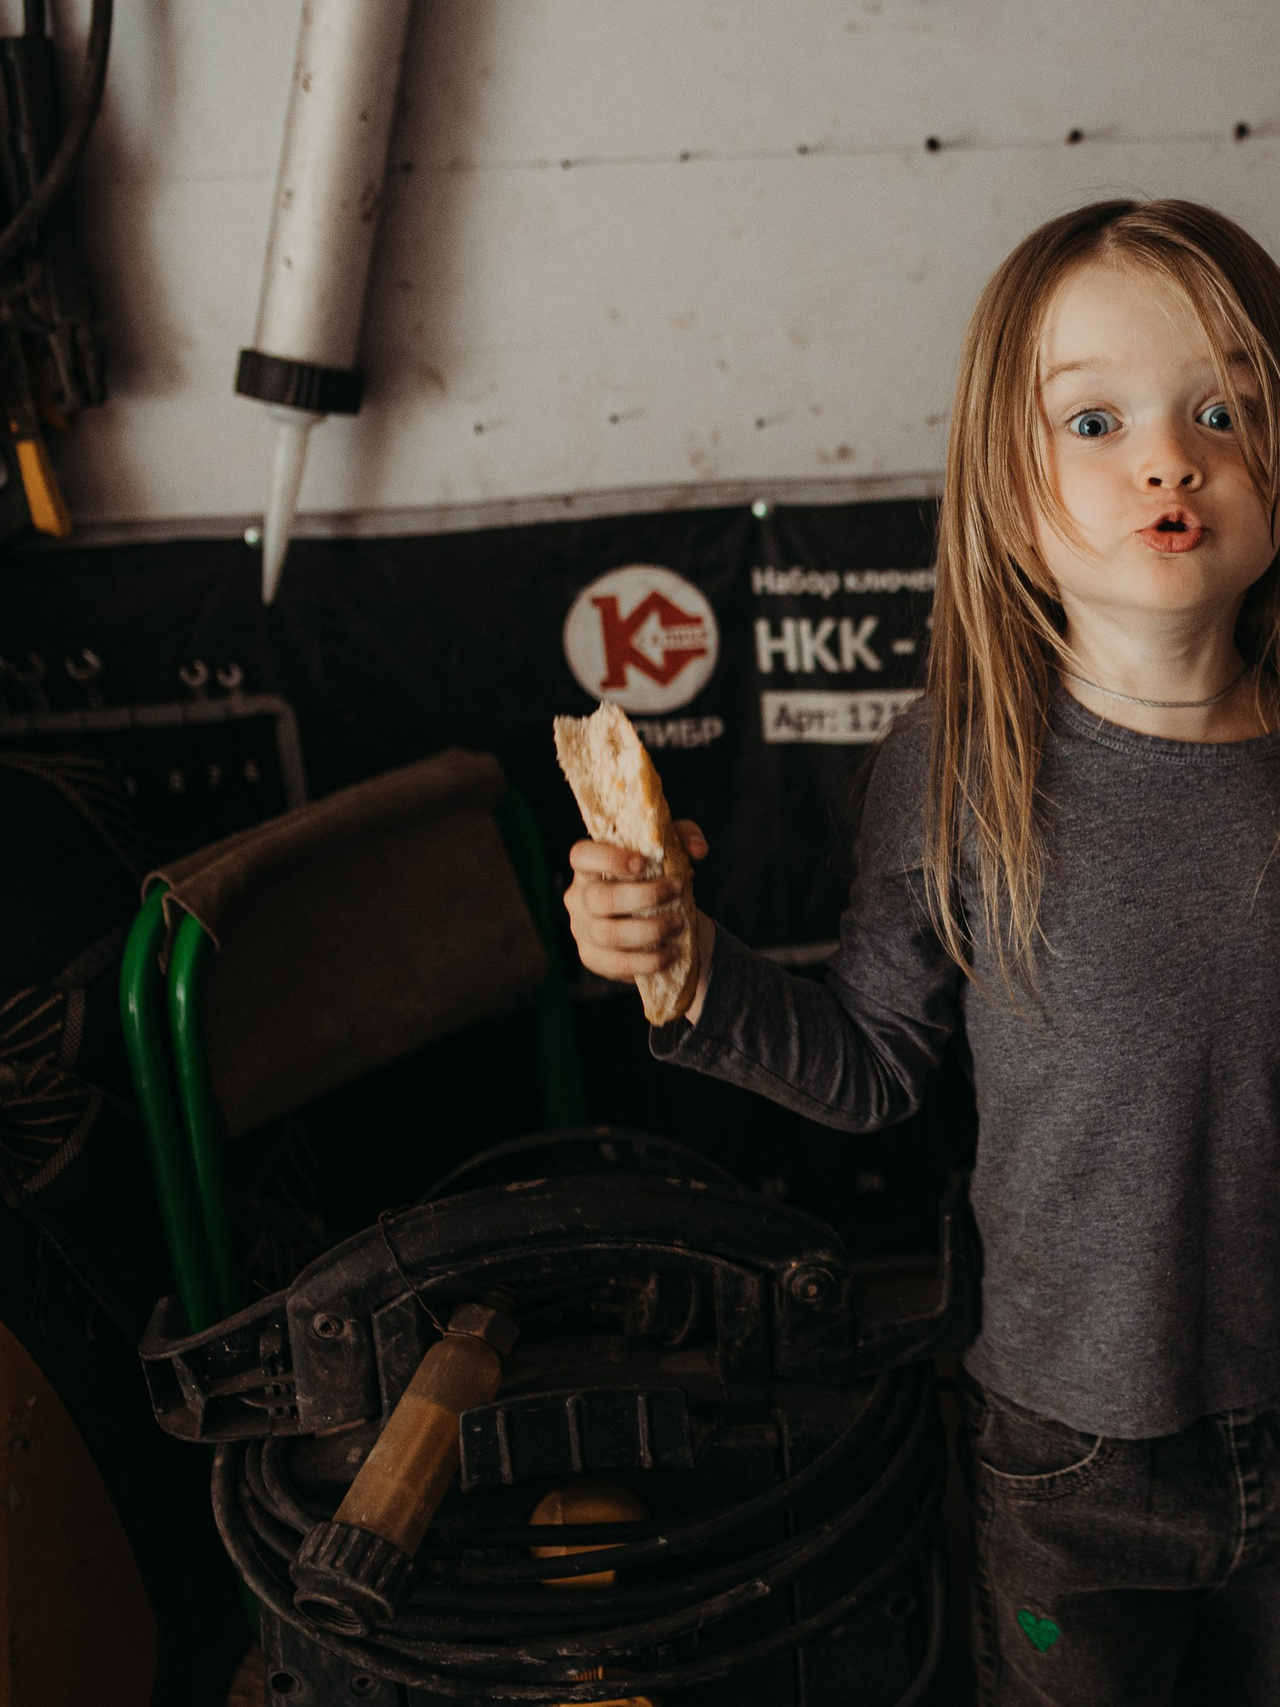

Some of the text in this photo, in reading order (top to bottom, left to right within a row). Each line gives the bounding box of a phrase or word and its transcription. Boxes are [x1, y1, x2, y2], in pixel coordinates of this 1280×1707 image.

[752, 566, 840, 599] Набор
[754, 616, 882, 674] НКК
[633, 716, 723, 748] ЛИБР
